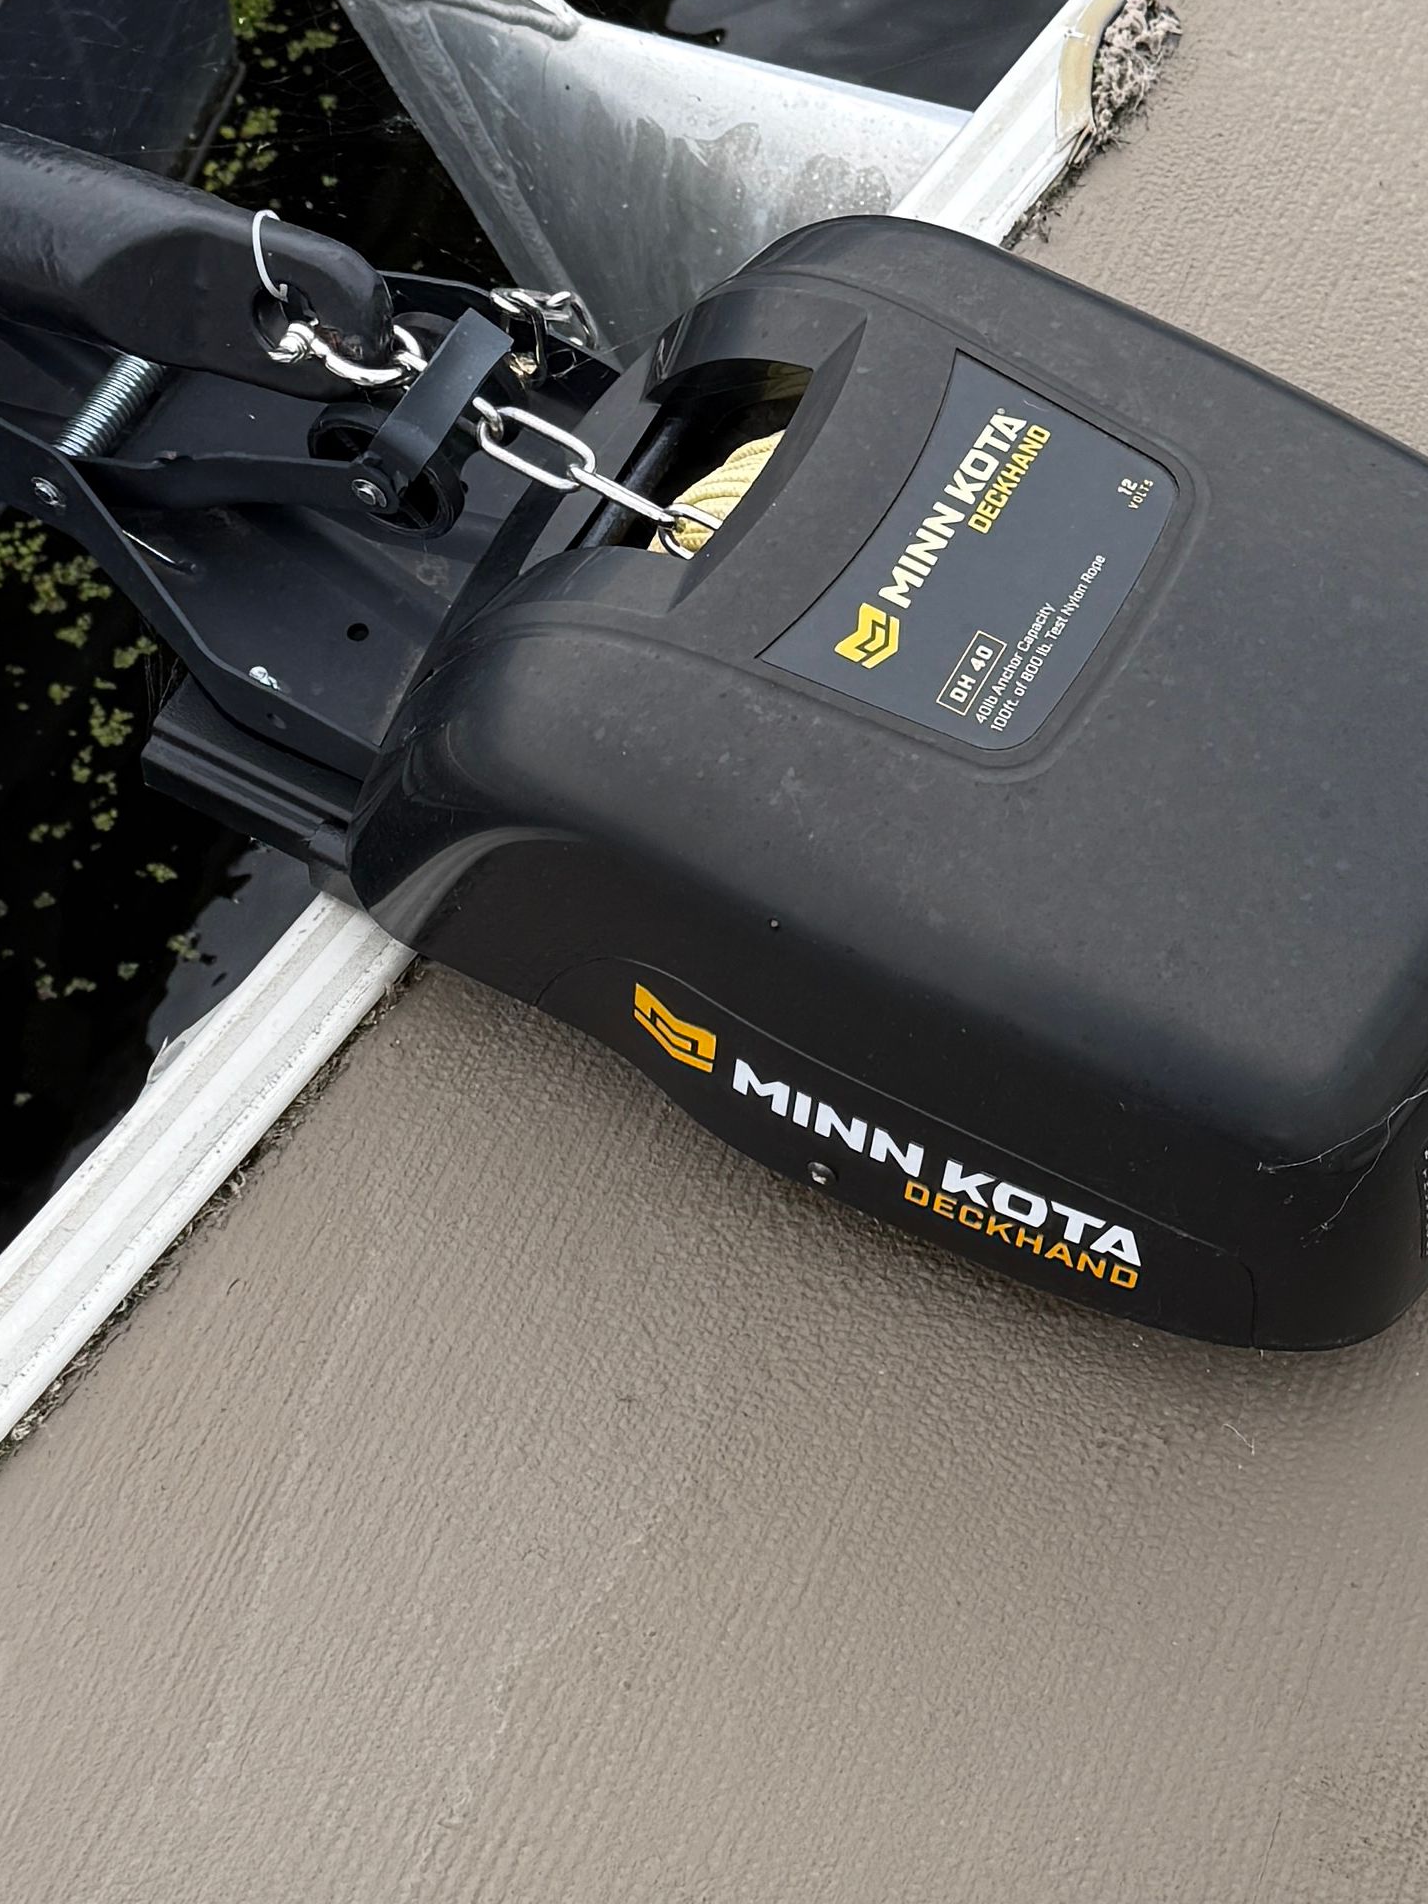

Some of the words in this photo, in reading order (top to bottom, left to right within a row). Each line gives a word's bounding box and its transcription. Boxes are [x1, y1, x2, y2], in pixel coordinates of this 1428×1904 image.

[967, 424, 1051, 534] DECKHAND
[1117, 478, 1138, 495] 12
[1127, 479, 1154, 509] VOLTS
[878, 501, 966, 609] MINN
[943, 414, 1028, 505] KOTA
[1080, 554, 1106, 584] Rope
[1060, 583, 1088, 617] Nylon
[1044, 615, 1069, 640] Test
[975, 695, 999, 724] 40lb
[991, 650, 1024, 696] Anchor
[1016, 602, 1057, 652] Capacity
[1035, 643, 1054, 657] lb.
[949, 674, 977, 703] DH
[970, 645, 994, 672] 40
[1020, 656, 1044, 682] 800
[1015, 681, 1028, 697] of
[990, 696, 1019, 732] 100ft.
[732, 1057, 925, 1178] MINN
[942, 1159, 1142, 1267] KOTA
[904, 1180, 1139, 1290] DECKHAND
